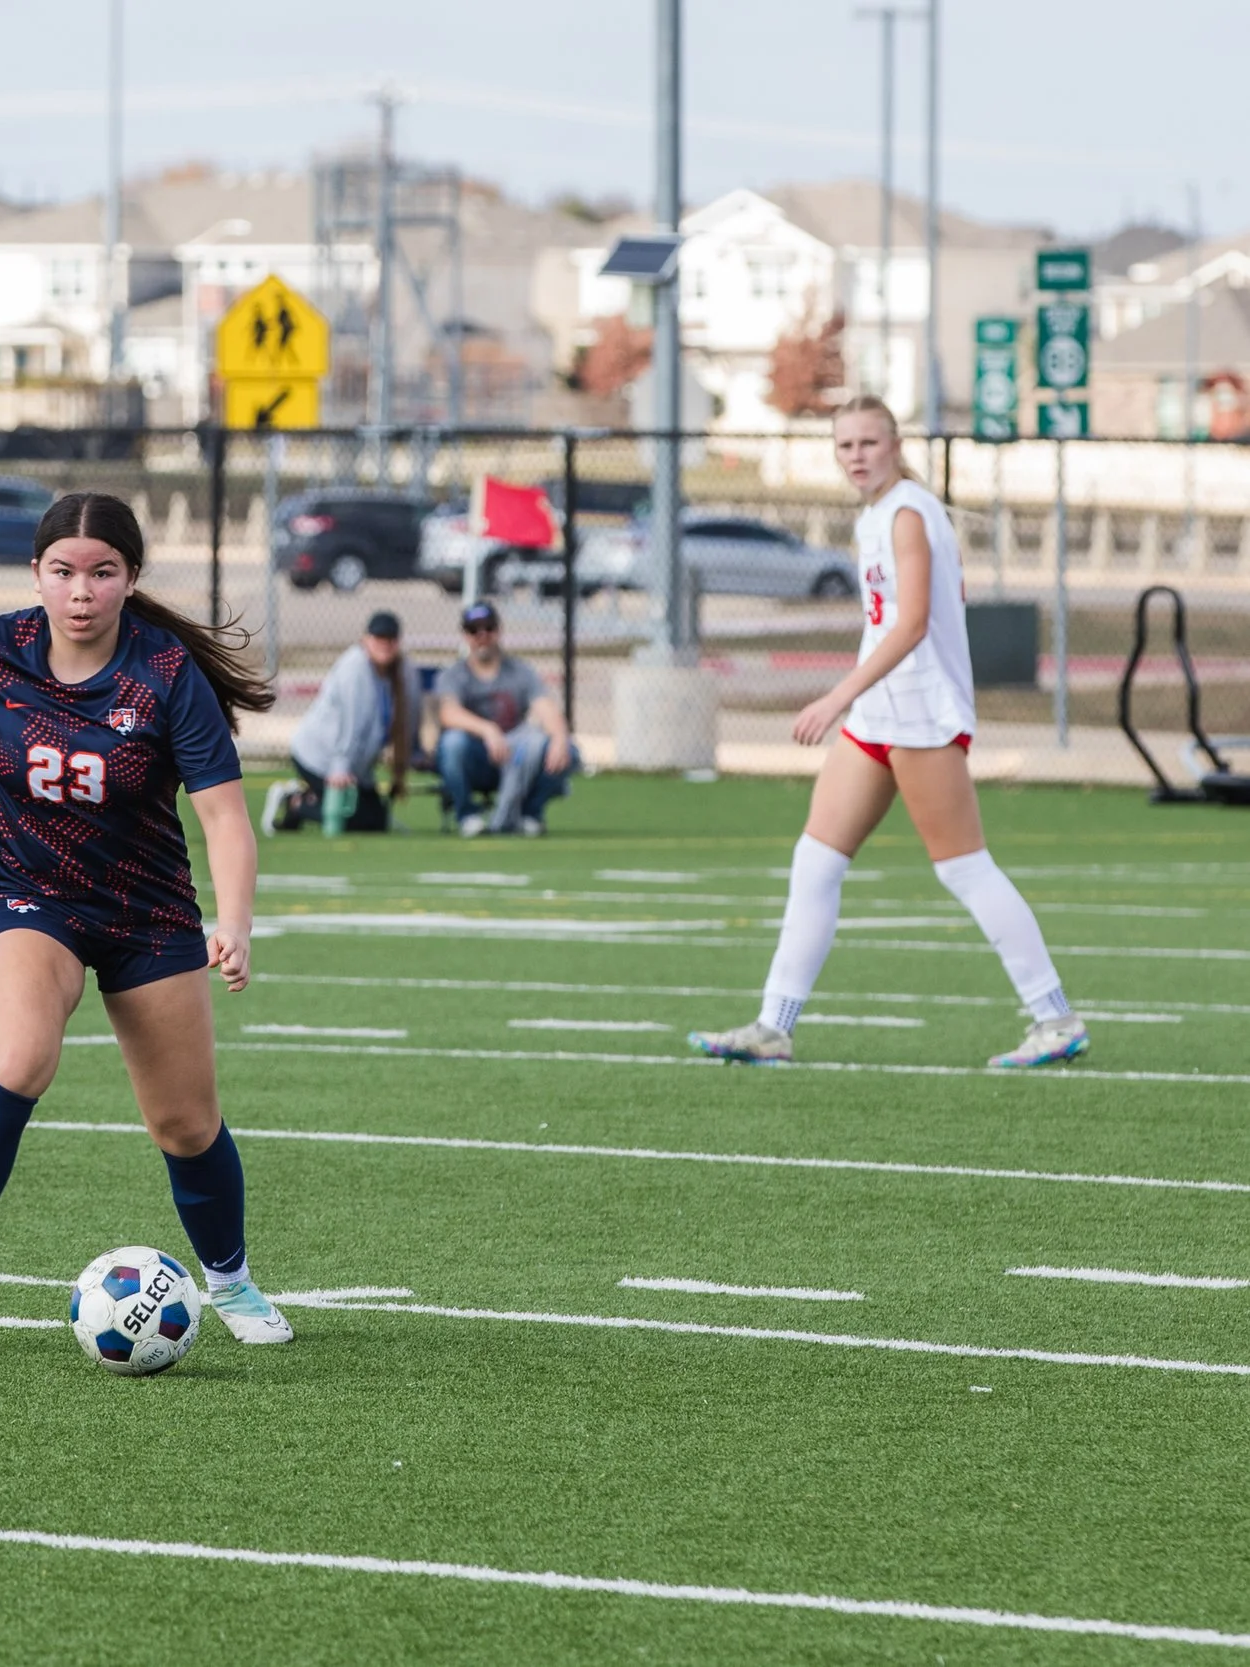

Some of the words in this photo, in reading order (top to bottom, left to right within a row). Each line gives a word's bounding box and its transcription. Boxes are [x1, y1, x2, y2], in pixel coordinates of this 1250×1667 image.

[27, 743, 106, 804] 23
[123, 1269, 175, 1336] SELECT
[141, 1348, 164, 1365] GHS
